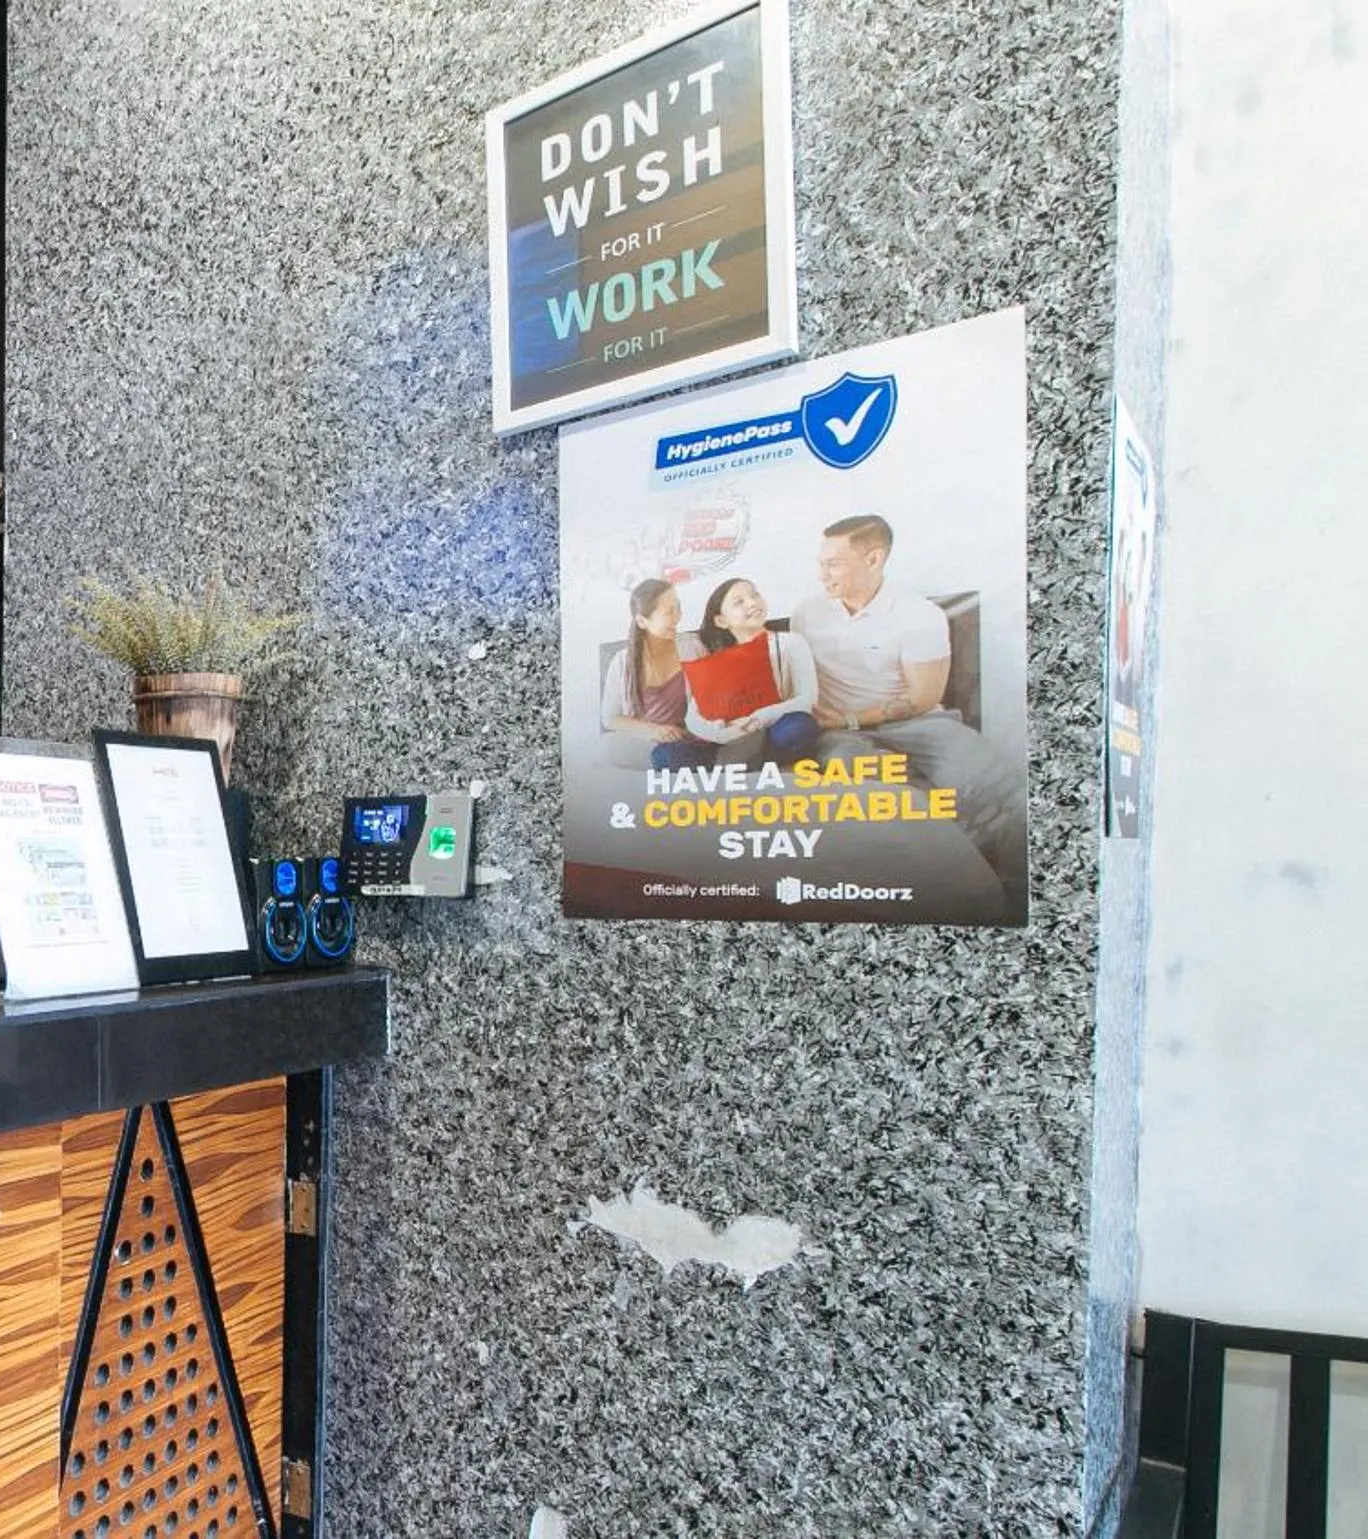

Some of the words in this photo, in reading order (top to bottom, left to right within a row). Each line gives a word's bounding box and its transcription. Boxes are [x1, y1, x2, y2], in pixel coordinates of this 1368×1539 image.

[540, 61, 725, 182] DON'T
[543, 124, 723, 237] WISH
[600, 232, 641, 261] FOR
[646, 222, 665, 246] IT
[546, 239, 725, 341] WORK
[603, 335, 644, 363] FOR
[650, 327, 669, 350] IT
[666, 419, 793, 460] HygienePass
[664, 462, 727, 482] OFFICIALLY
[731, 447, 794, 469] CERTIFIED
[647, 764, 746, 794] HAVE
[756, 761, 786, 789] A
[793, 754, 909, 789] SAFE
[611, 802, 635, 829] &
[644, 788, 958, 828] COMFORTABLE
[719, 828, 823, 860] STAY
[643, 882, 696, 899] Officially
[701, 883, 761, 899] certified:
[802, 884, 913, 902] RedDoorz
